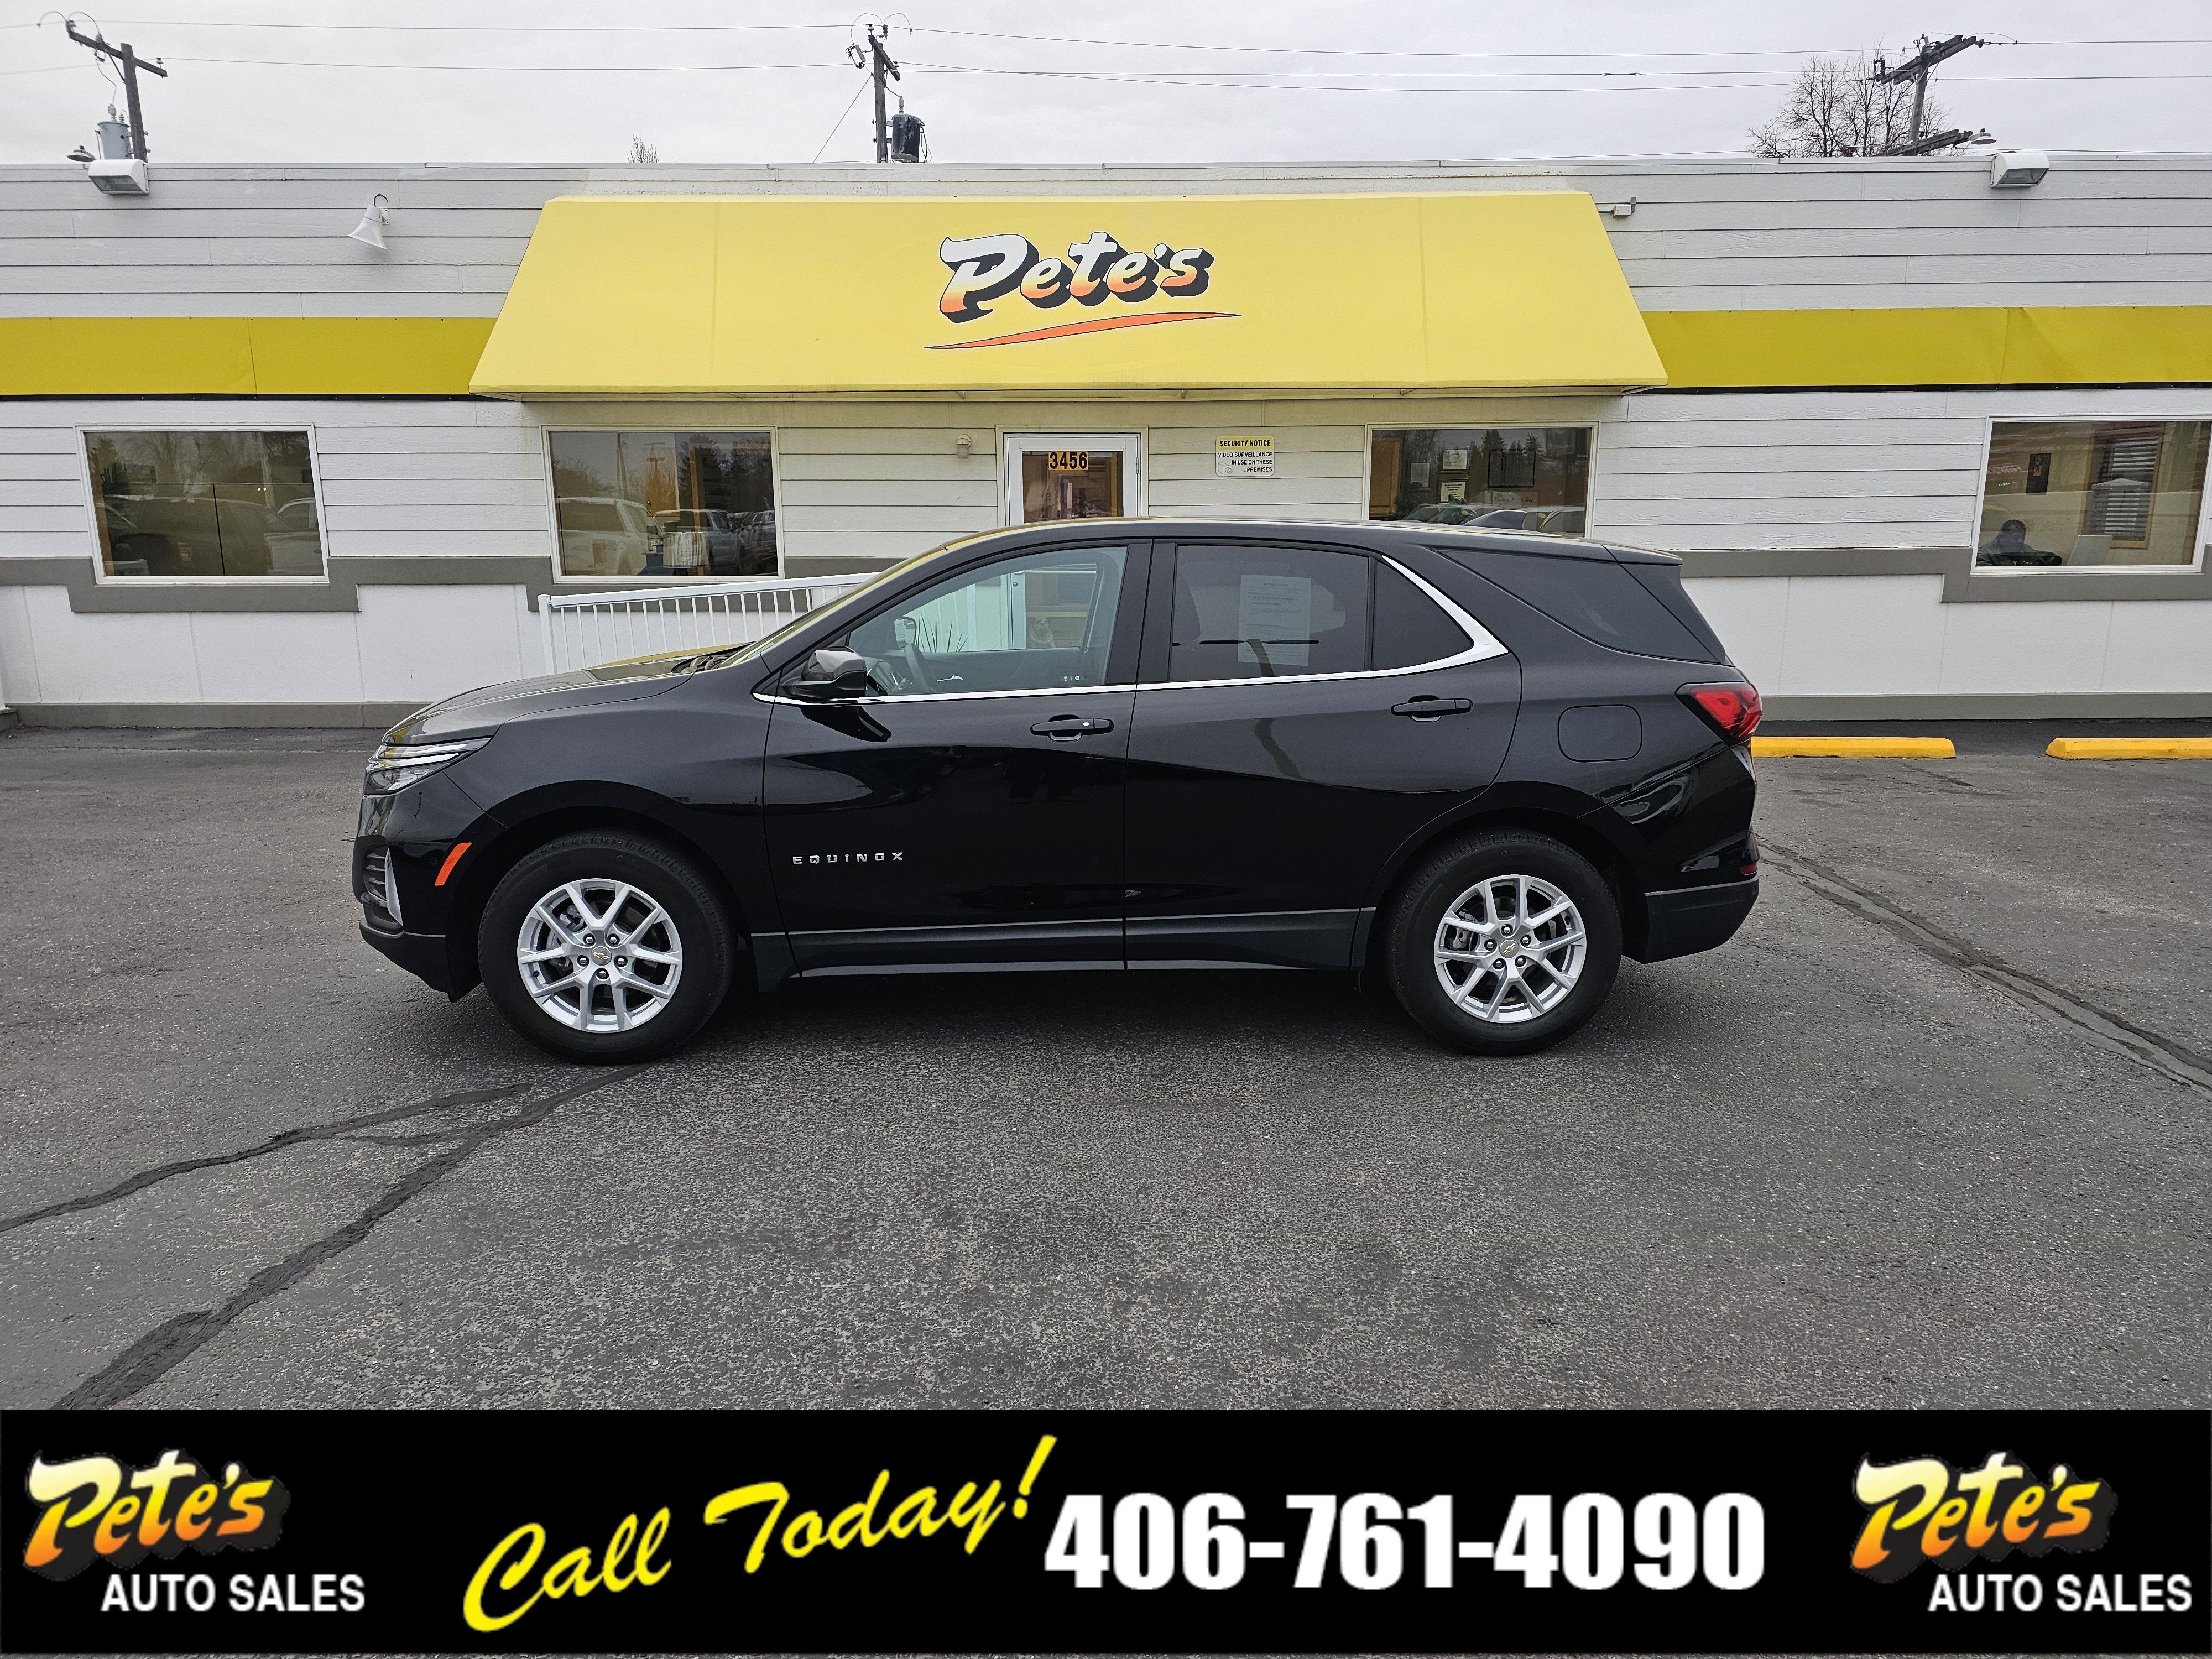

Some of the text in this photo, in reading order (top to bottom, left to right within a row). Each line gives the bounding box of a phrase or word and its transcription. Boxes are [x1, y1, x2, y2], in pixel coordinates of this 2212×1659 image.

[940, 231, 1214, 323] Pete's
[1049, 452, 1087, 469] 3456
[793, 852, 902, 864] EQUINOX
